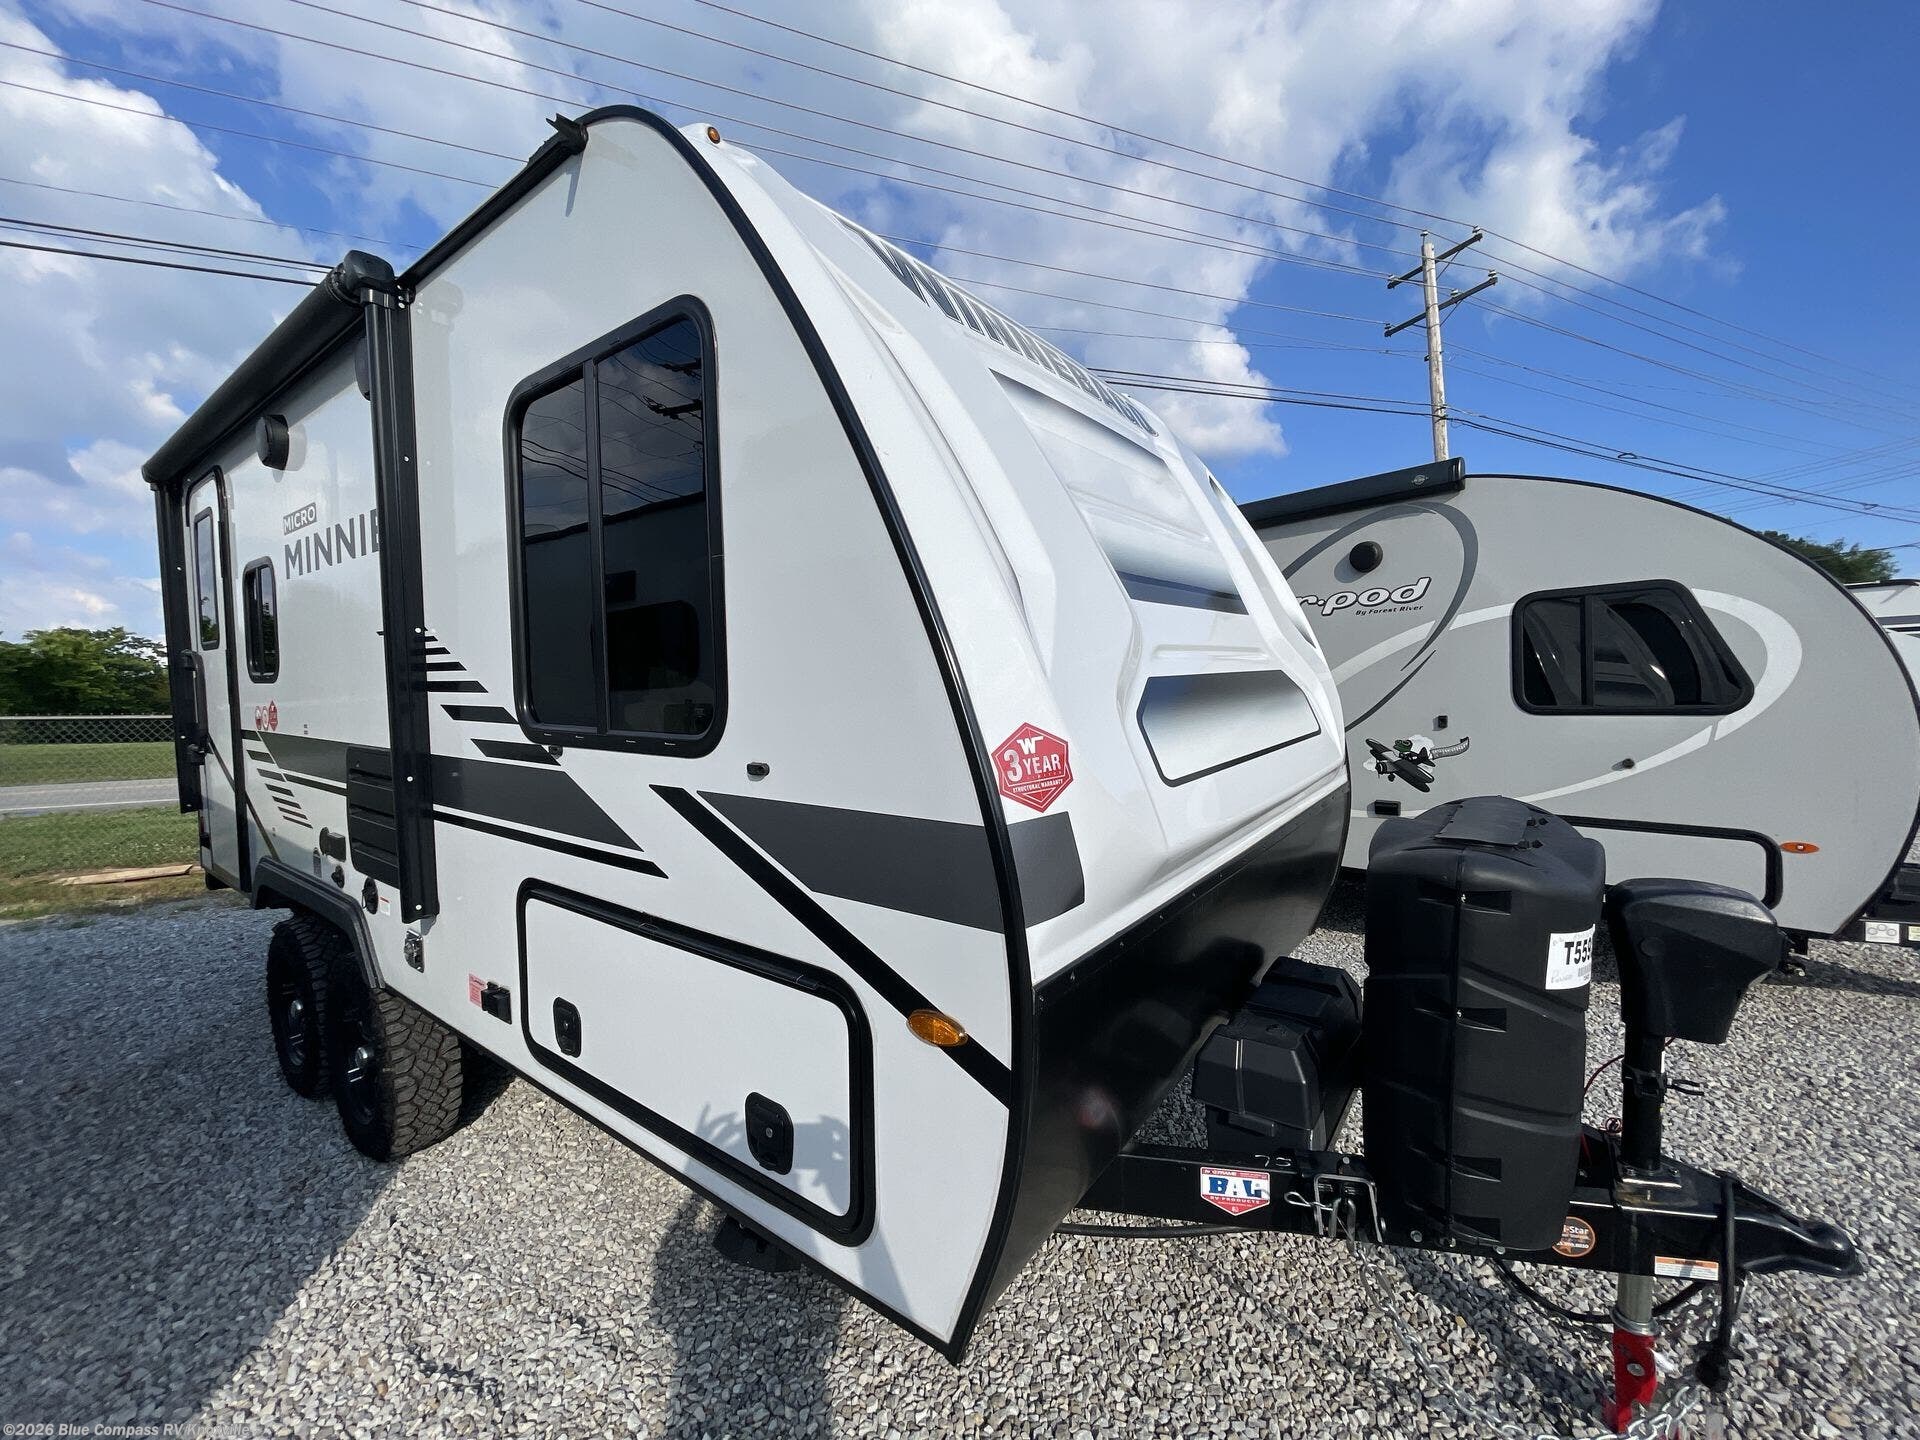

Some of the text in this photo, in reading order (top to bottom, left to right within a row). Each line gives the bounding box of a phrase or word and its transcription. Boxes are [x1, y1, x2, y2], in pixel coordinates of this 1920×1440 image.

[834, 213, 1159, 437] WINNEBAGO
[283, 504, 316, 533] MICRO
[1368, 607, 1397, 615] Forest
[1003, 749, 1062, 782] 3 YEAR
